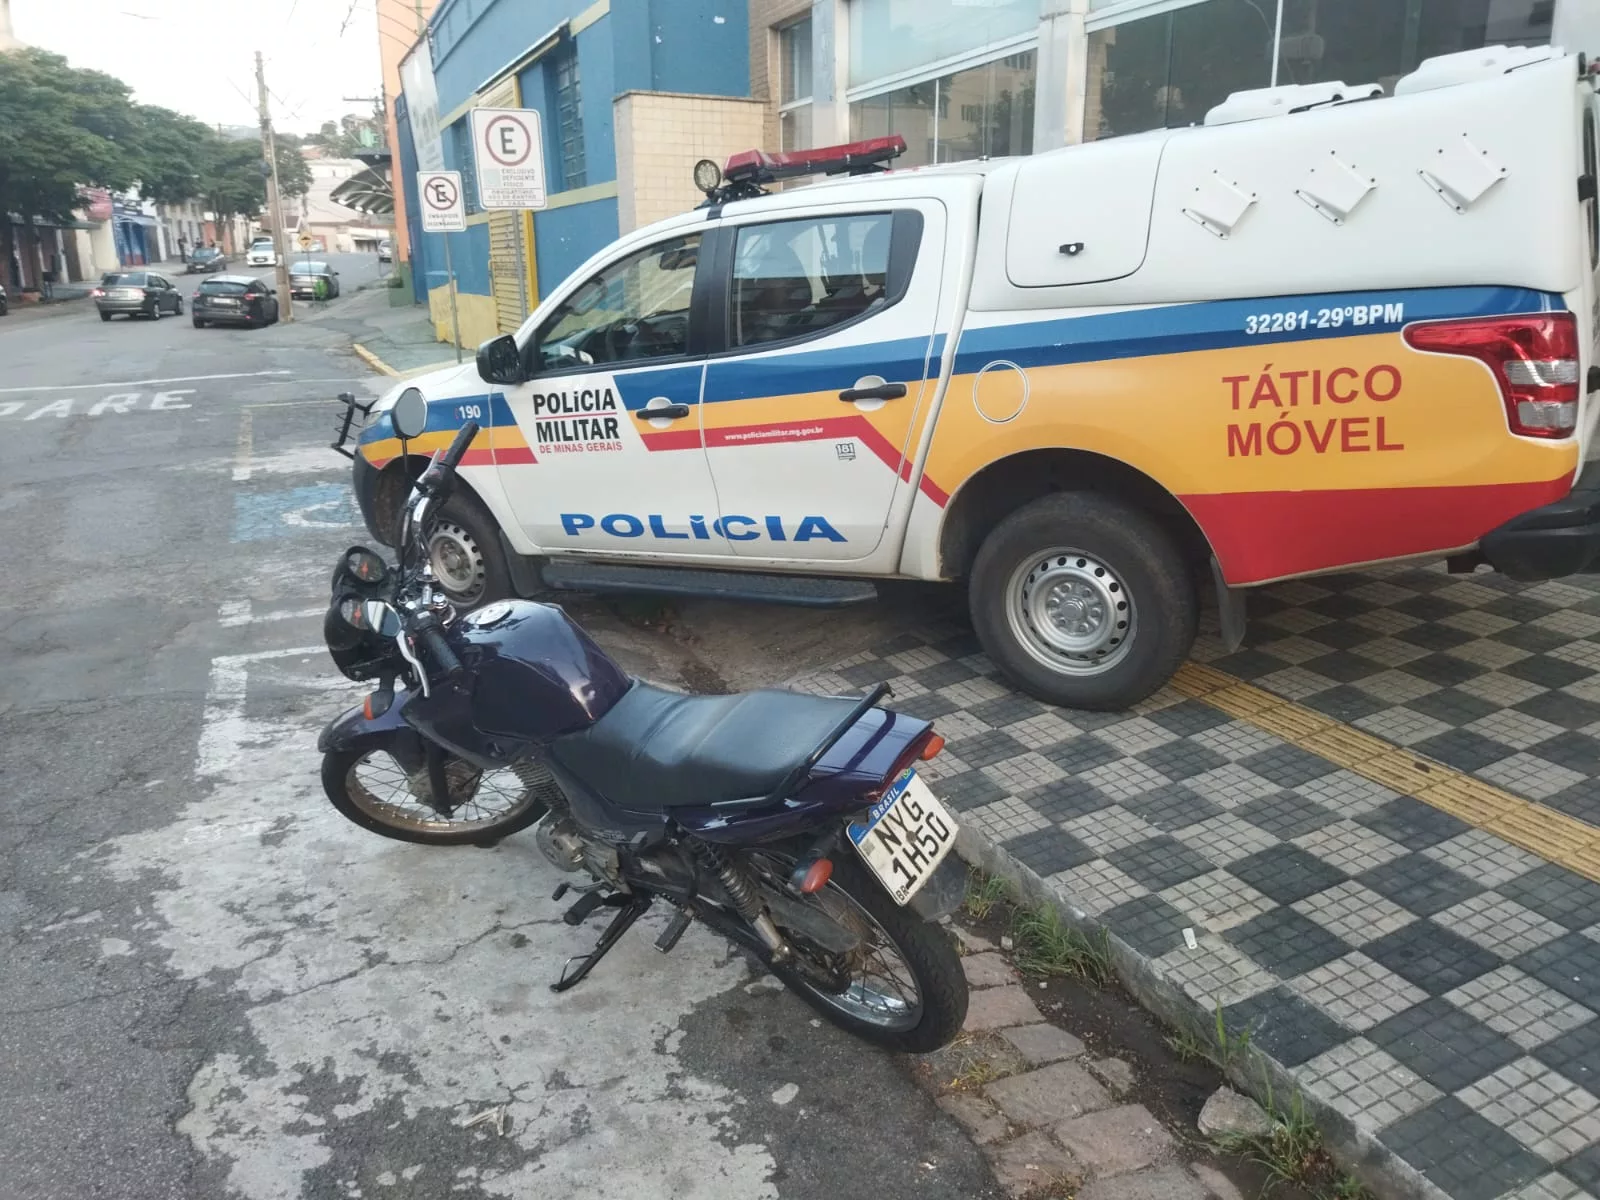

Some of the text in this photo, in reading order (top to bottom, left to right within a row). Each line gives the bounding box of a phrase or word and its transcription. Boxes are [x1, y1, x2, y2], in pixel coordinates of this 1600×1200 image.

[500, 127, 516, 154] E
[435, 184, 447, 202] E
[1222, 363, 1402, 410] TÁTICO
[459, 405, 481, 419] 190
[536, 417, 619, 443] MILITAR
[724, 426, 824, 441] www.policiamilitar.mg.gov.br
[1227, 411, 1404, 457] MÓVEL
[540, 441, 622, 453] DE MINAS GERAIS
[837, 444, 854, 454] 181
[872, 788, 900, 820] BRASIL
[873, 790, 924, 855] NYG
[895, 885, 909, 900] BR
